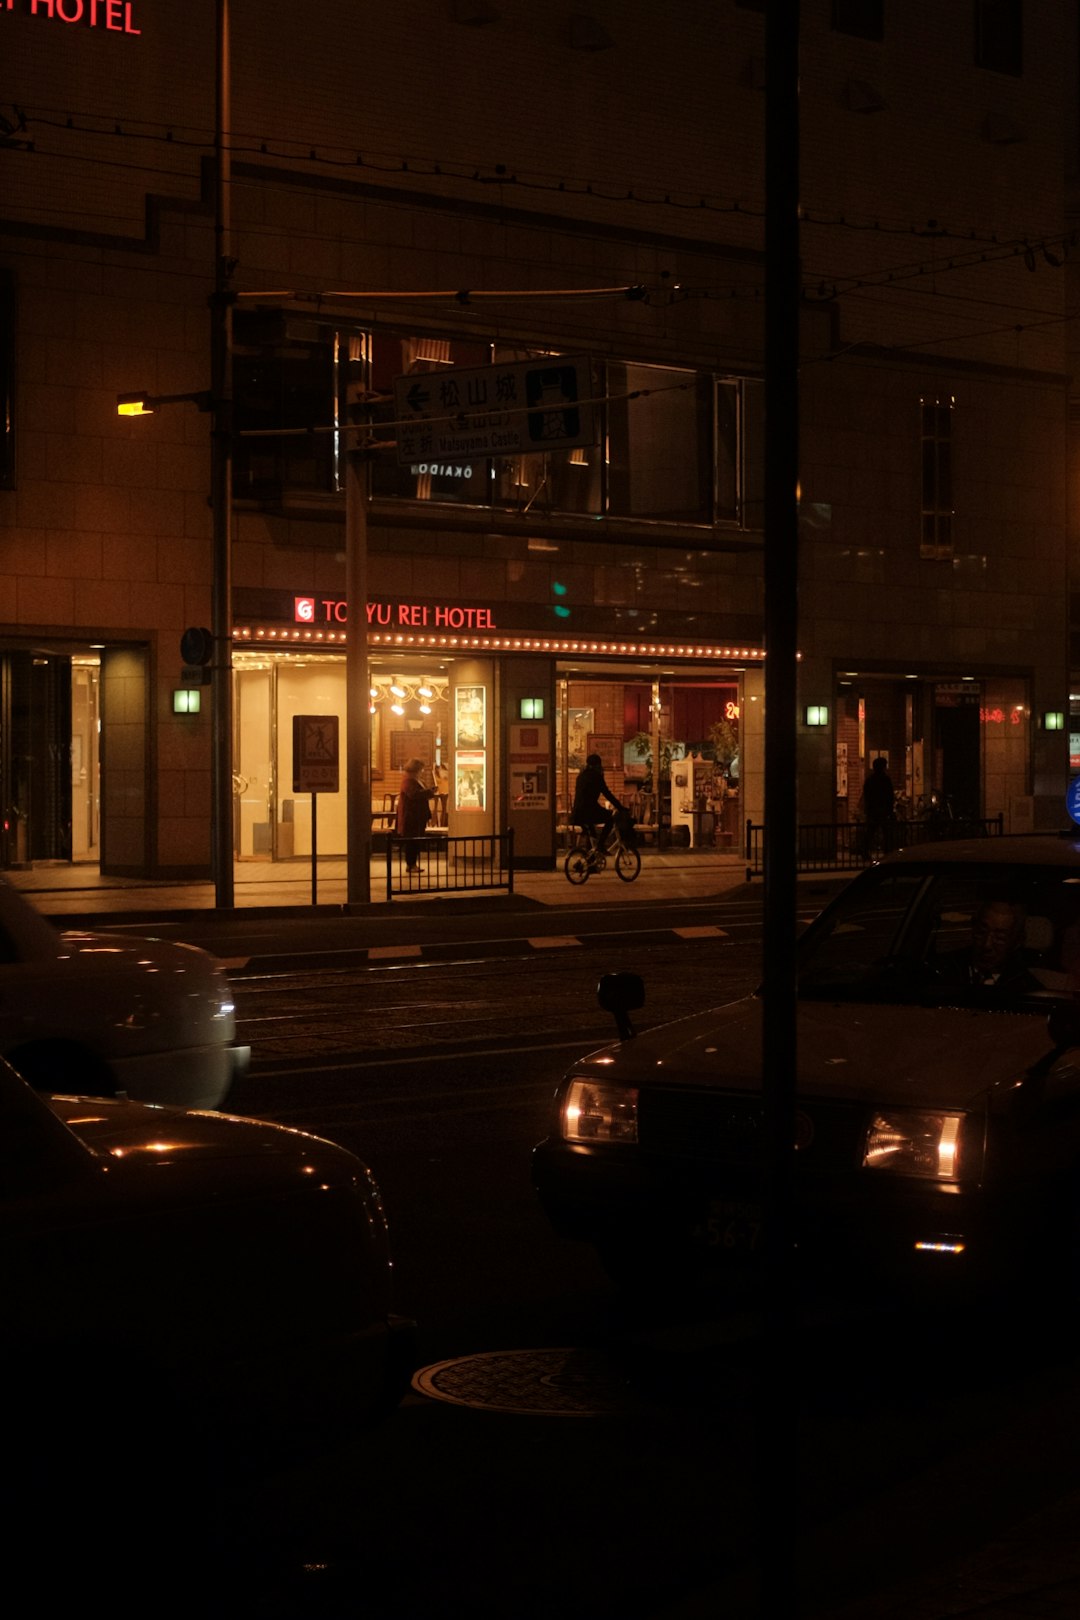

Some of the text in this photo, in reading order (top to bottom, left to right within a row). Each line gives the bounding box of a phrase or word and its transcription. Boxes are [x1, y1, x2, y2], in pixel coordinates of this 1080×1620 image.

[440, 373, 517, 409] 松山城
[439, 431, 521, 455] Matsuyama Castle
[322, 600, 497, 629] TOYU REI HOTEL
